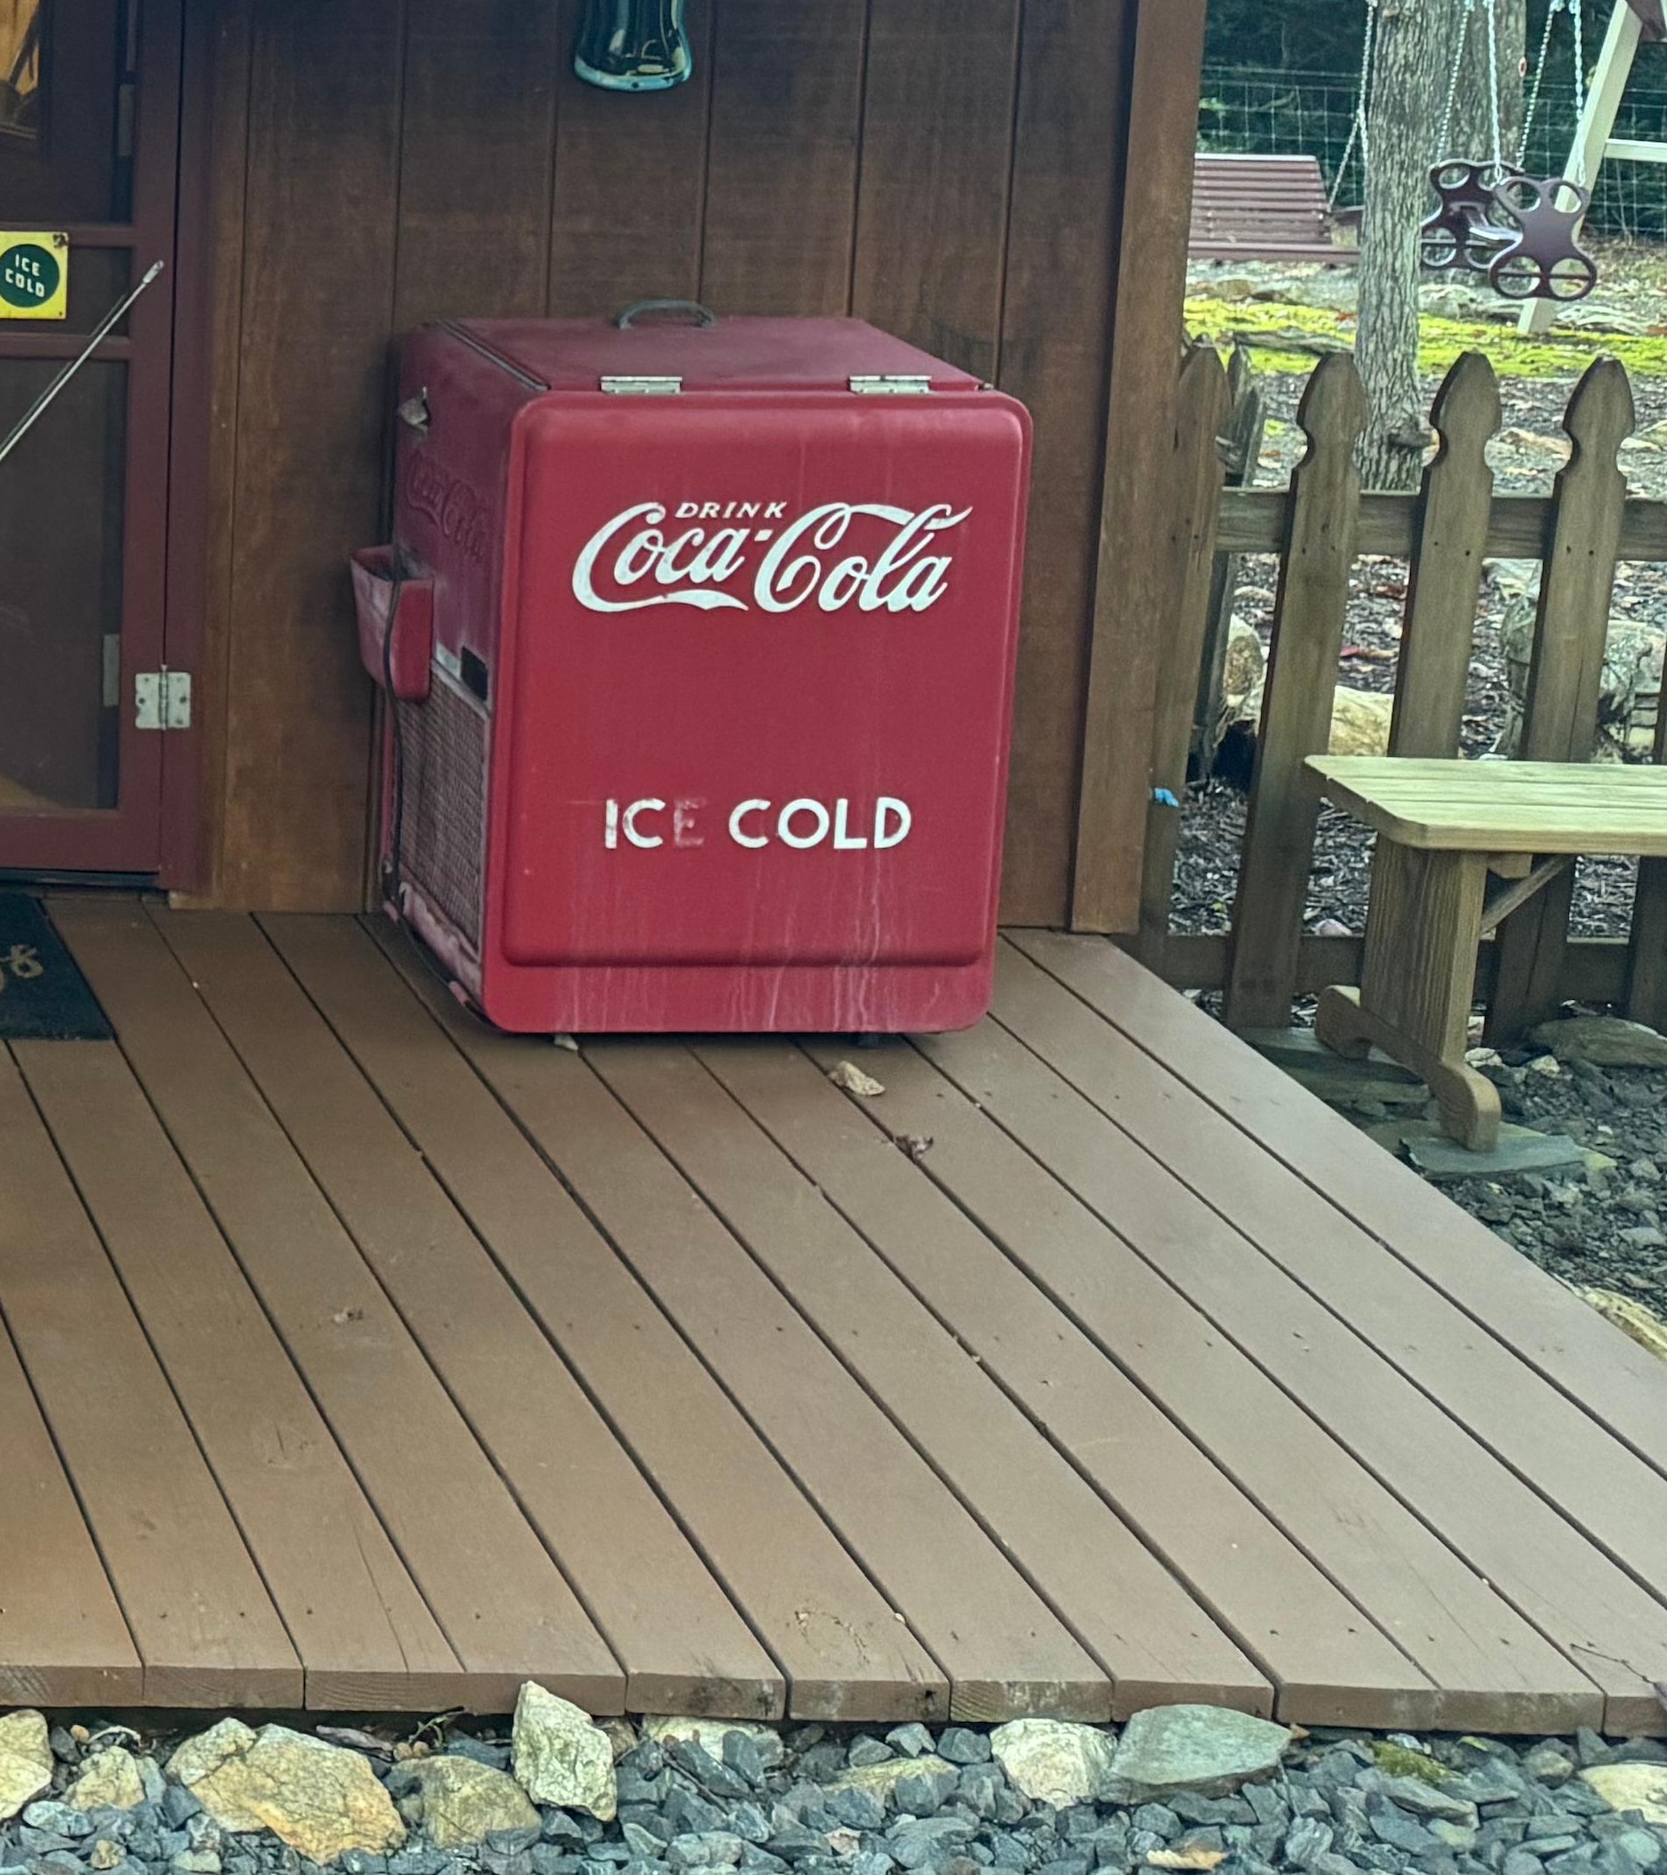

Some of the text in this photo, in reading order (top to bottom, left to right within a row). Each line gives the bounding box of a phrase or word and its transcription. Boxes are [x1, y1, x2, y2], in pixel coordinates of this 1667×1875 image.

[15, 254, 42, 277] ICE
[5, 268, 45, 298] COLD
[675, 501, 788, 519] DRINK
[571, 501, 974, 613] Coca-Cola
[604, 796, 912, 849] ICE COLD
